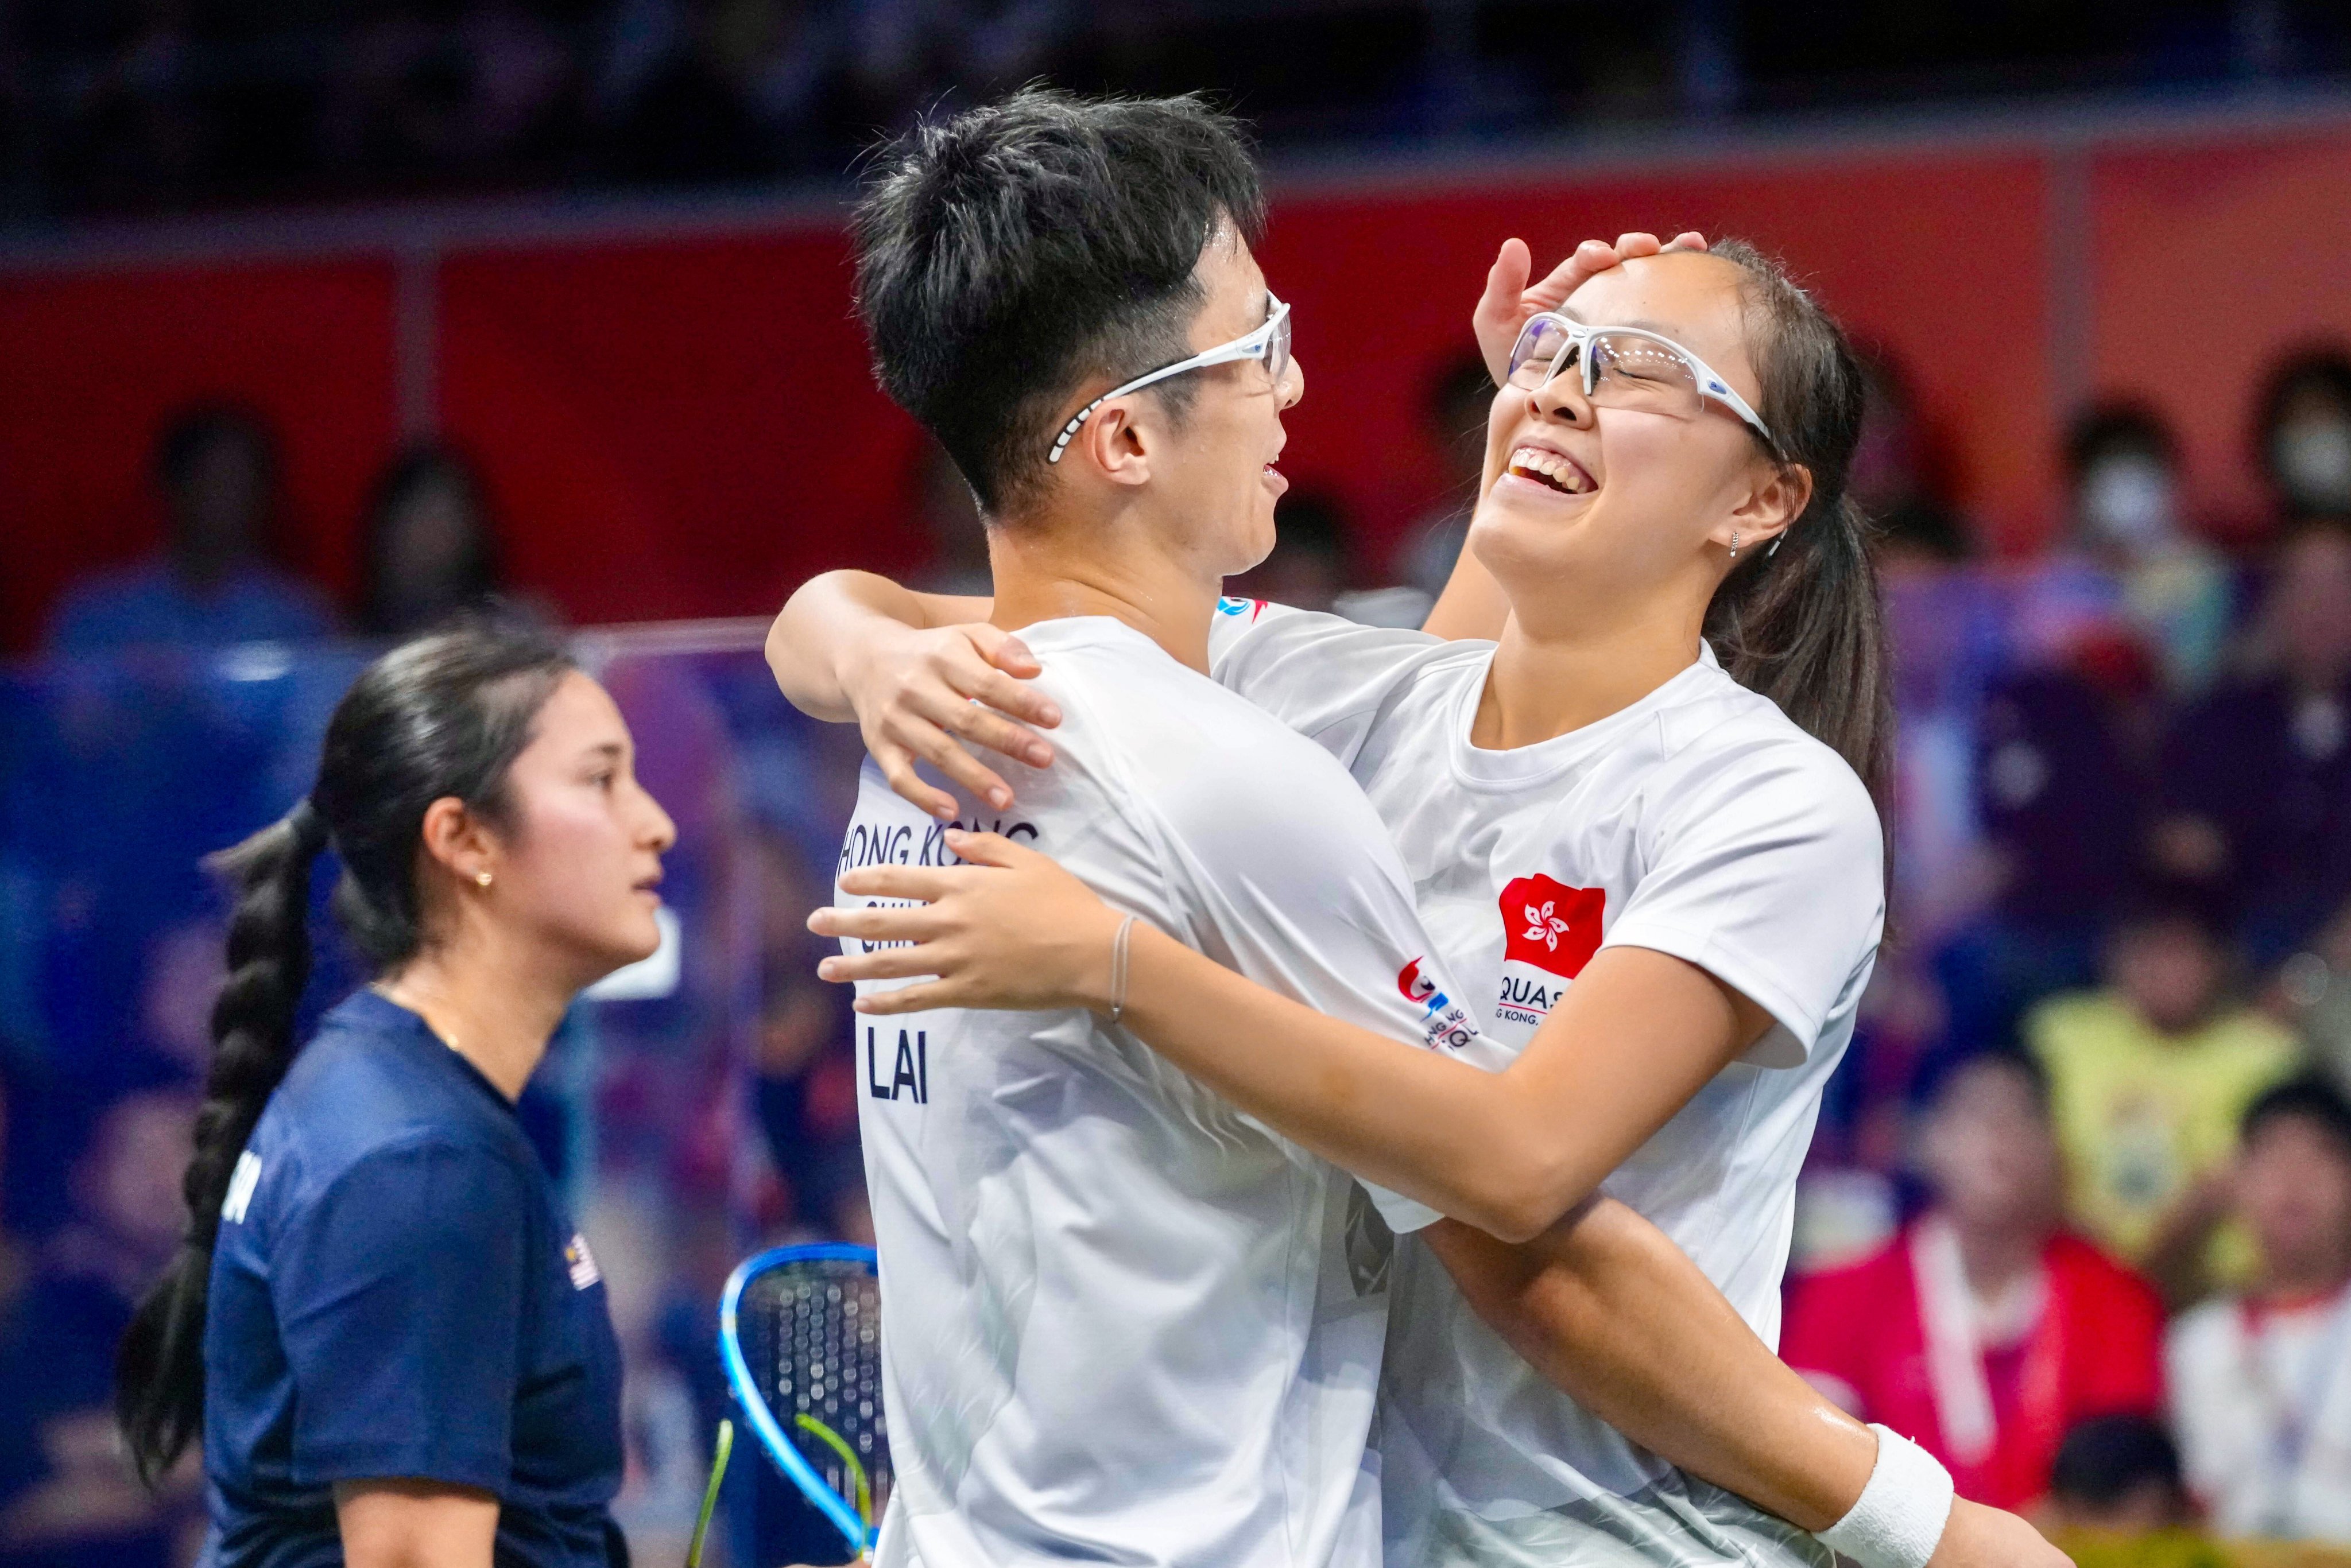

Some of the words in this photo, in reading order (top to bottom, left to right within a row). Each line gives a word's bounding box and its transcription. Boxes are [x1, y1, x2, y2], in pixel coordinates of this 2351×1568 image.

[838, 822, 912, 877] HONG
[919, 817, 1039, 866] KO
[1505, 1010, 1539, 1026] KONG,
[867, 1026, 928, 1104] LAI
